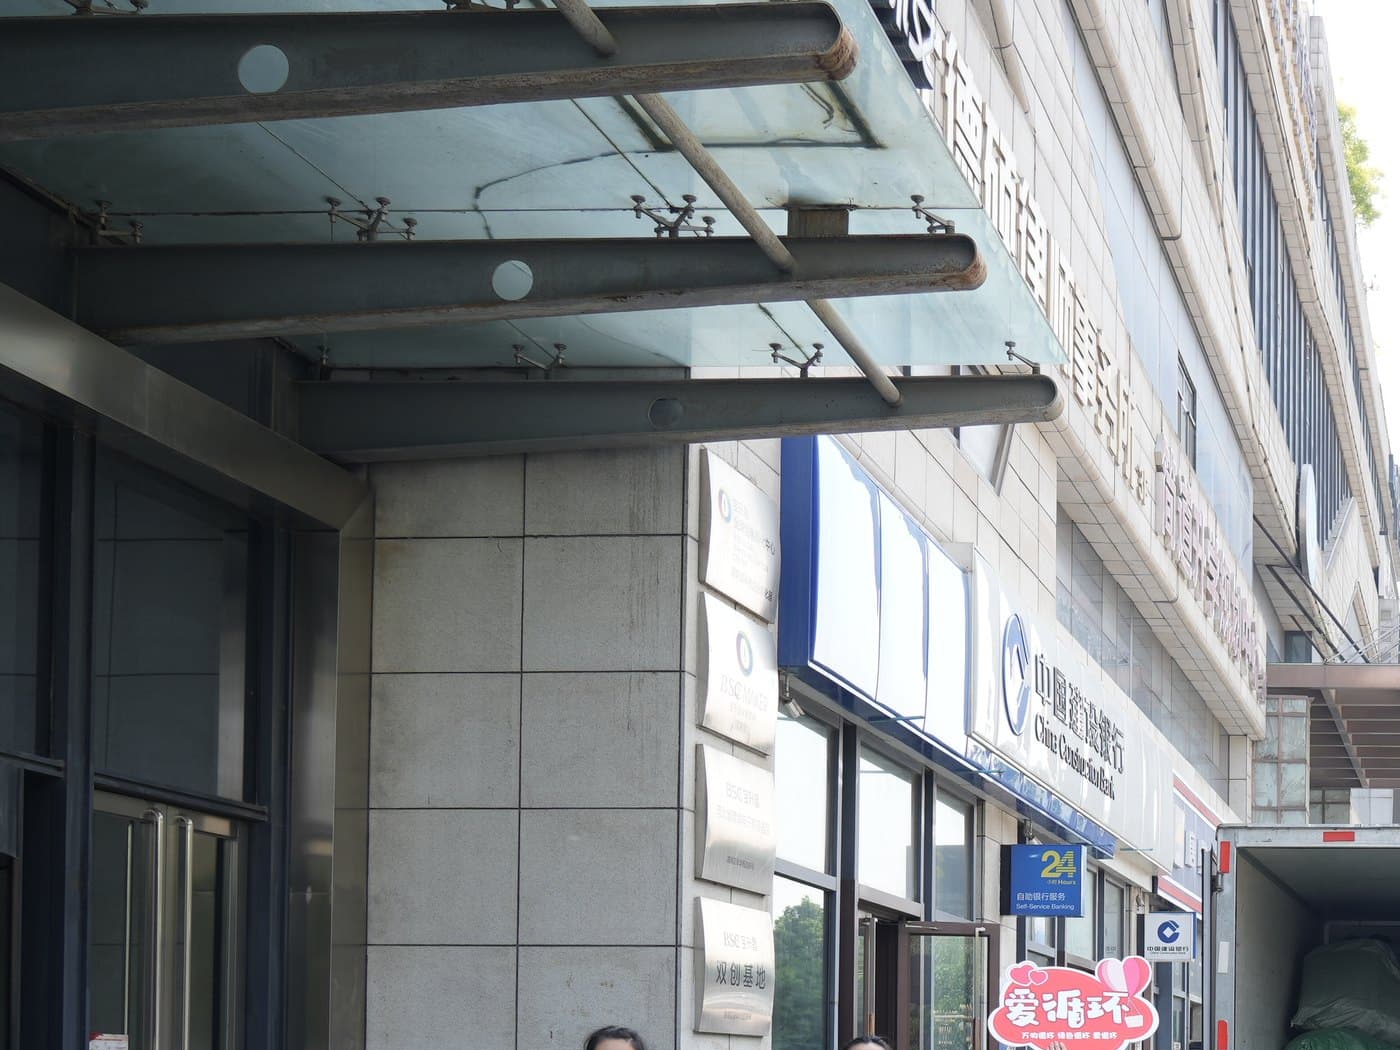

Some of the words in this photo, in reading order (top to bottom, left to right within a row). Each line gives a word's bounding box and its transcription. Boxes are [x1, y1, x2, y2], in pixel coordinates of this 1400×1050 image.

[1035, 654, 1124, 774] 中国建设银行
[1034, 713, 1057, 754] China
[1100, 767, 1115, 800] Bank
[1040, 850, 1077, 878] 24
[1016, 892, 1066, 901] 自助银行服务
[1051, 903, 1075, 911] Banking
[715, 960, 766, 989] 双创基地
[1004, 988, 1129, 1029] 爱循环
